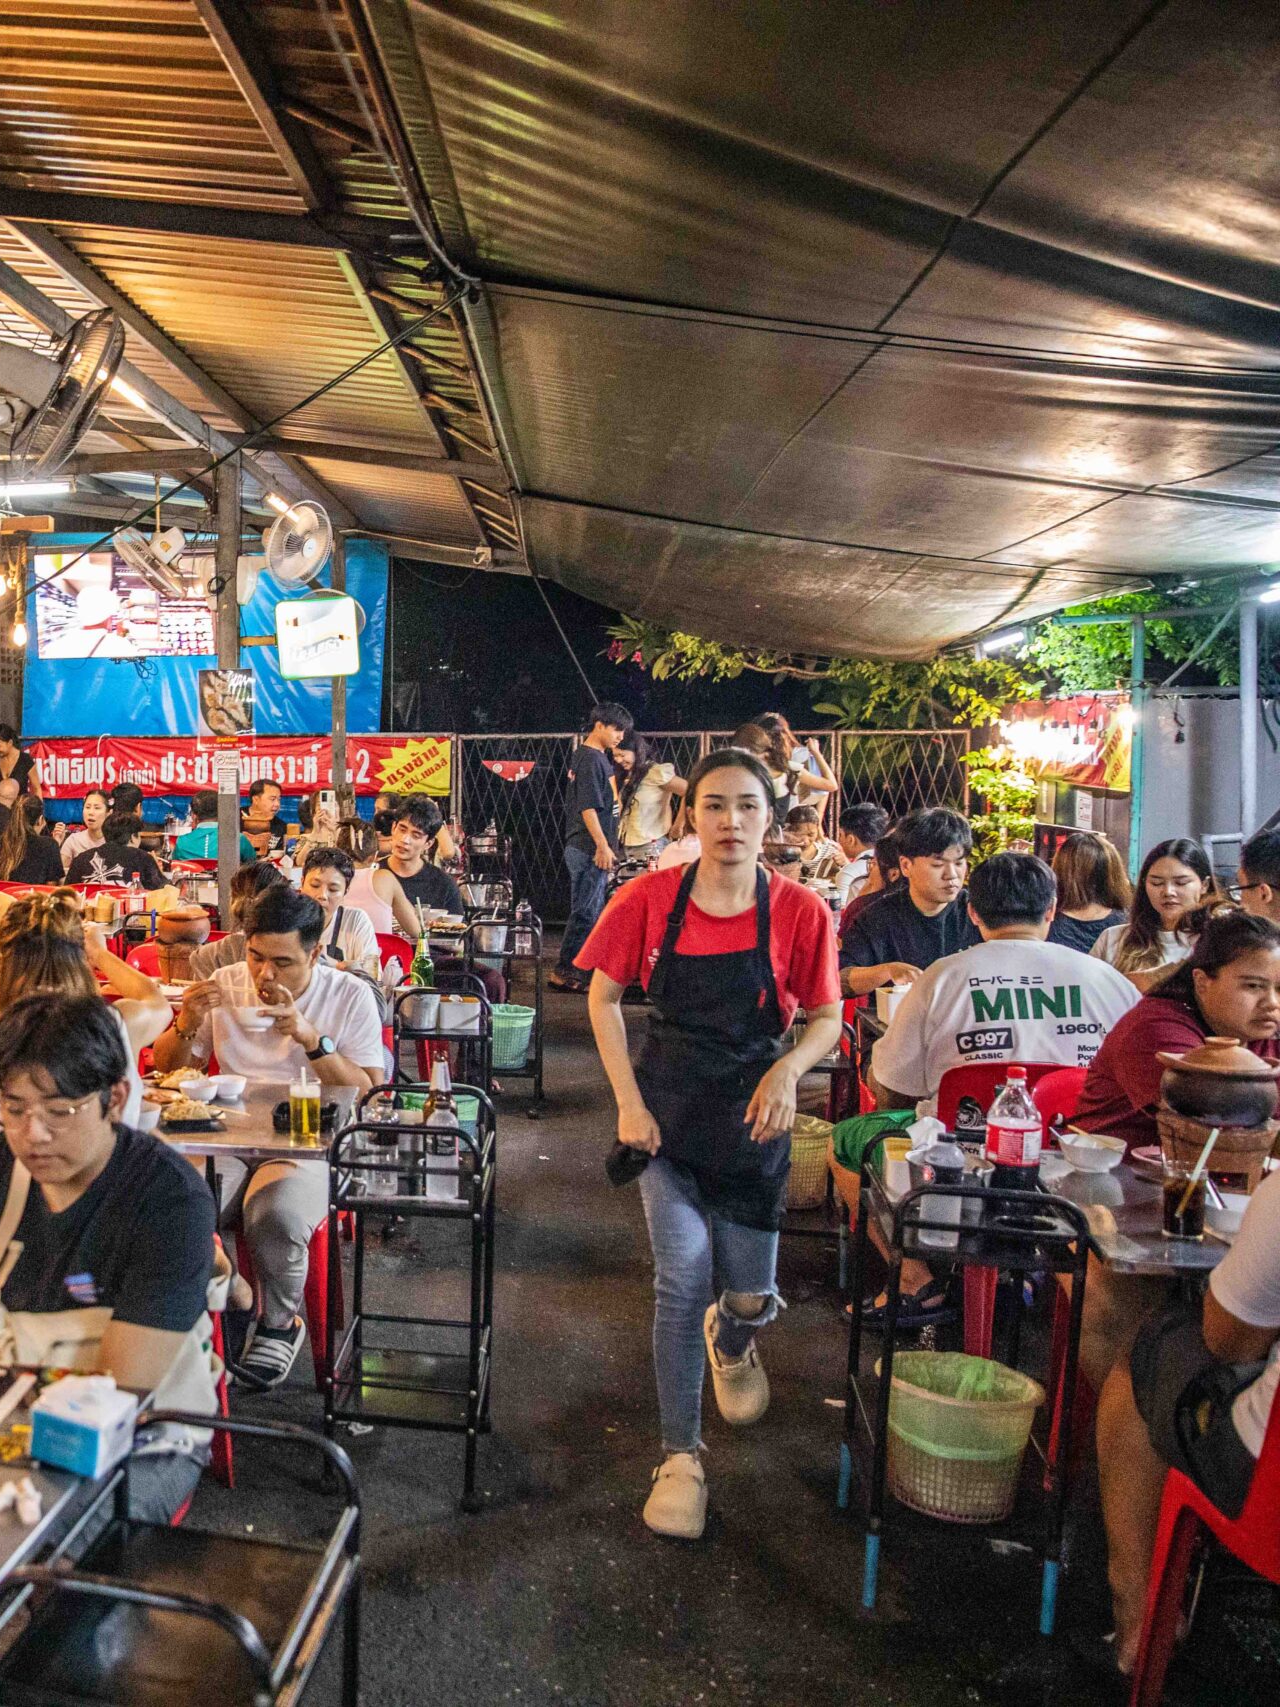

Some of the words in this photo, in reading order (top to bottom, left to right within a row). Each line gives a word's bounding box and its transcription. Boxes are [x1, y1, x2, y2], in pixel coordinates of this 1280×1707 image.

[356, 748, 370, 784] 2
[386, 746, 440, 785] ตรงข้าม
[969, 976, 1013, 987] ローバー
[1020, 975, 1044, 985] ミニ
[970, 985, 1082, 1023] MINI
[965, 1052, 1003, 1061] CLASSIC
